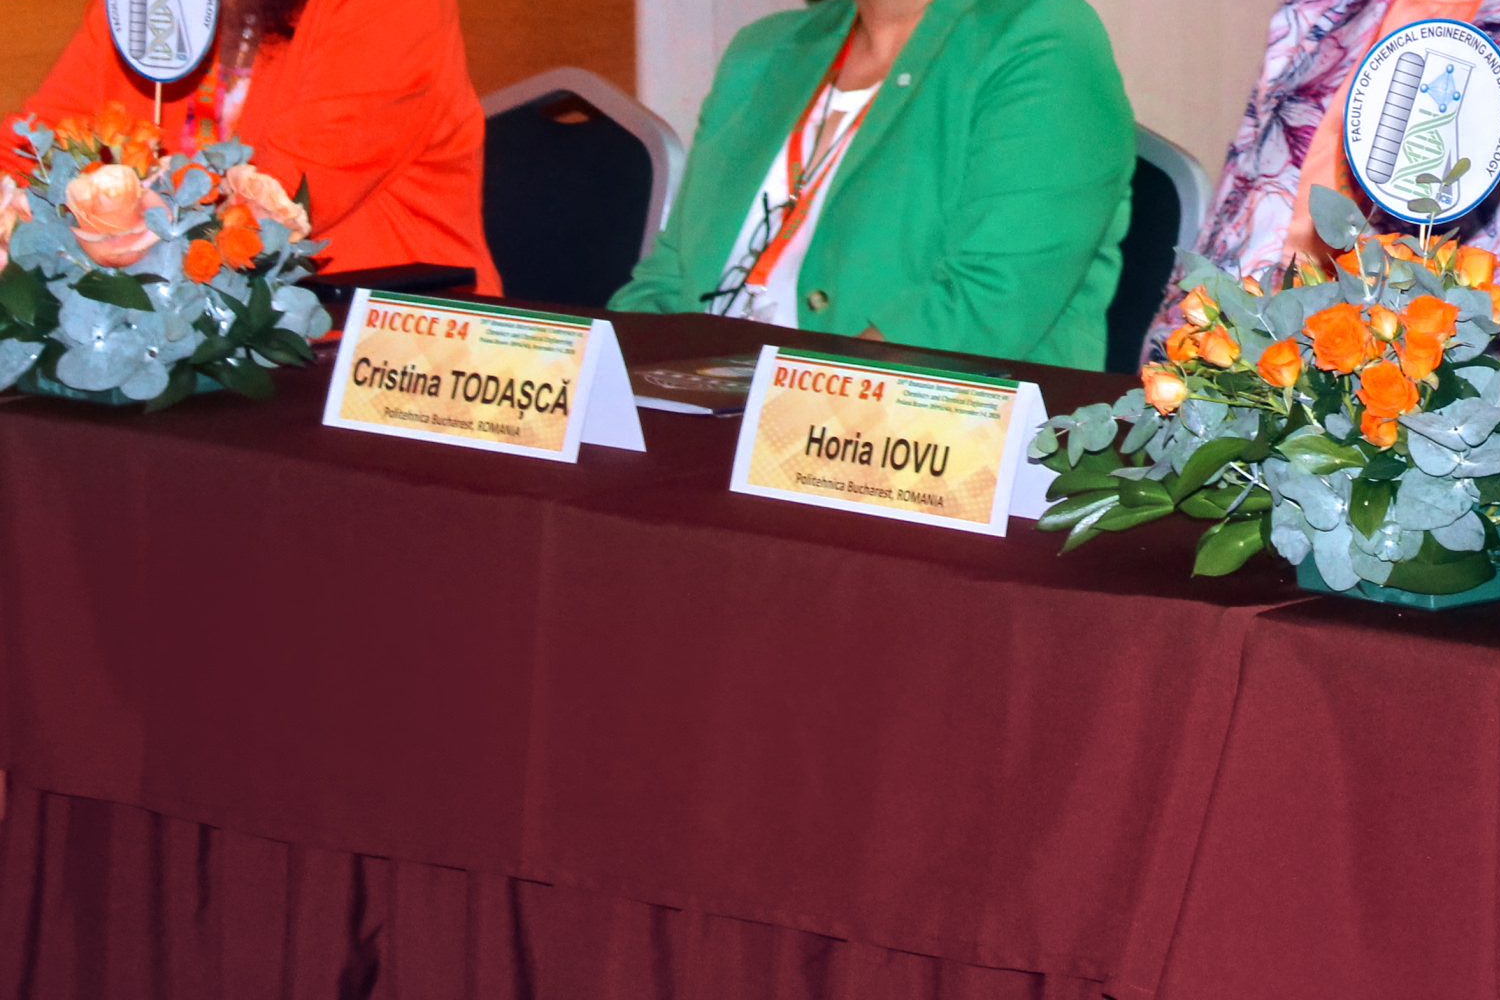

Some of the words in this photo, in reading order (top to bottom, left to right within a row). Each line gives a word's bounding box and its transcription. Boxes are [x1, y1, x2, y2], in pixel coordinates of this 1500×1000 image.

[1350, 89, 1366, 142] FACULTY
[1360, 72, 1372, 88] OF
[1369, 30, 1419, 72] CHEMICAL
[1420, 26, 1487, 56] ENGINEERING
[1483, 54, 1500, 75] AND
[366, 308, 439, 337] RICCCE
[445, 319, 470, 340] 24
[353, 357, 440, 398] Cristina
[774, 366, 852, 397] RICCCE
[859, 379, 885, 402] 24
[384, 405, 431, 425] Politehnica
[478, 419, 521, 437] ROMANIA
[805, 424, 872, 466] Horia
[881, 436, 949, 477] IOVU
[796, 472, 845, 492] Politehnica
[847, 480, 894, 501] Bucharest,
[897, 489, 944, 508] ROMANIA
